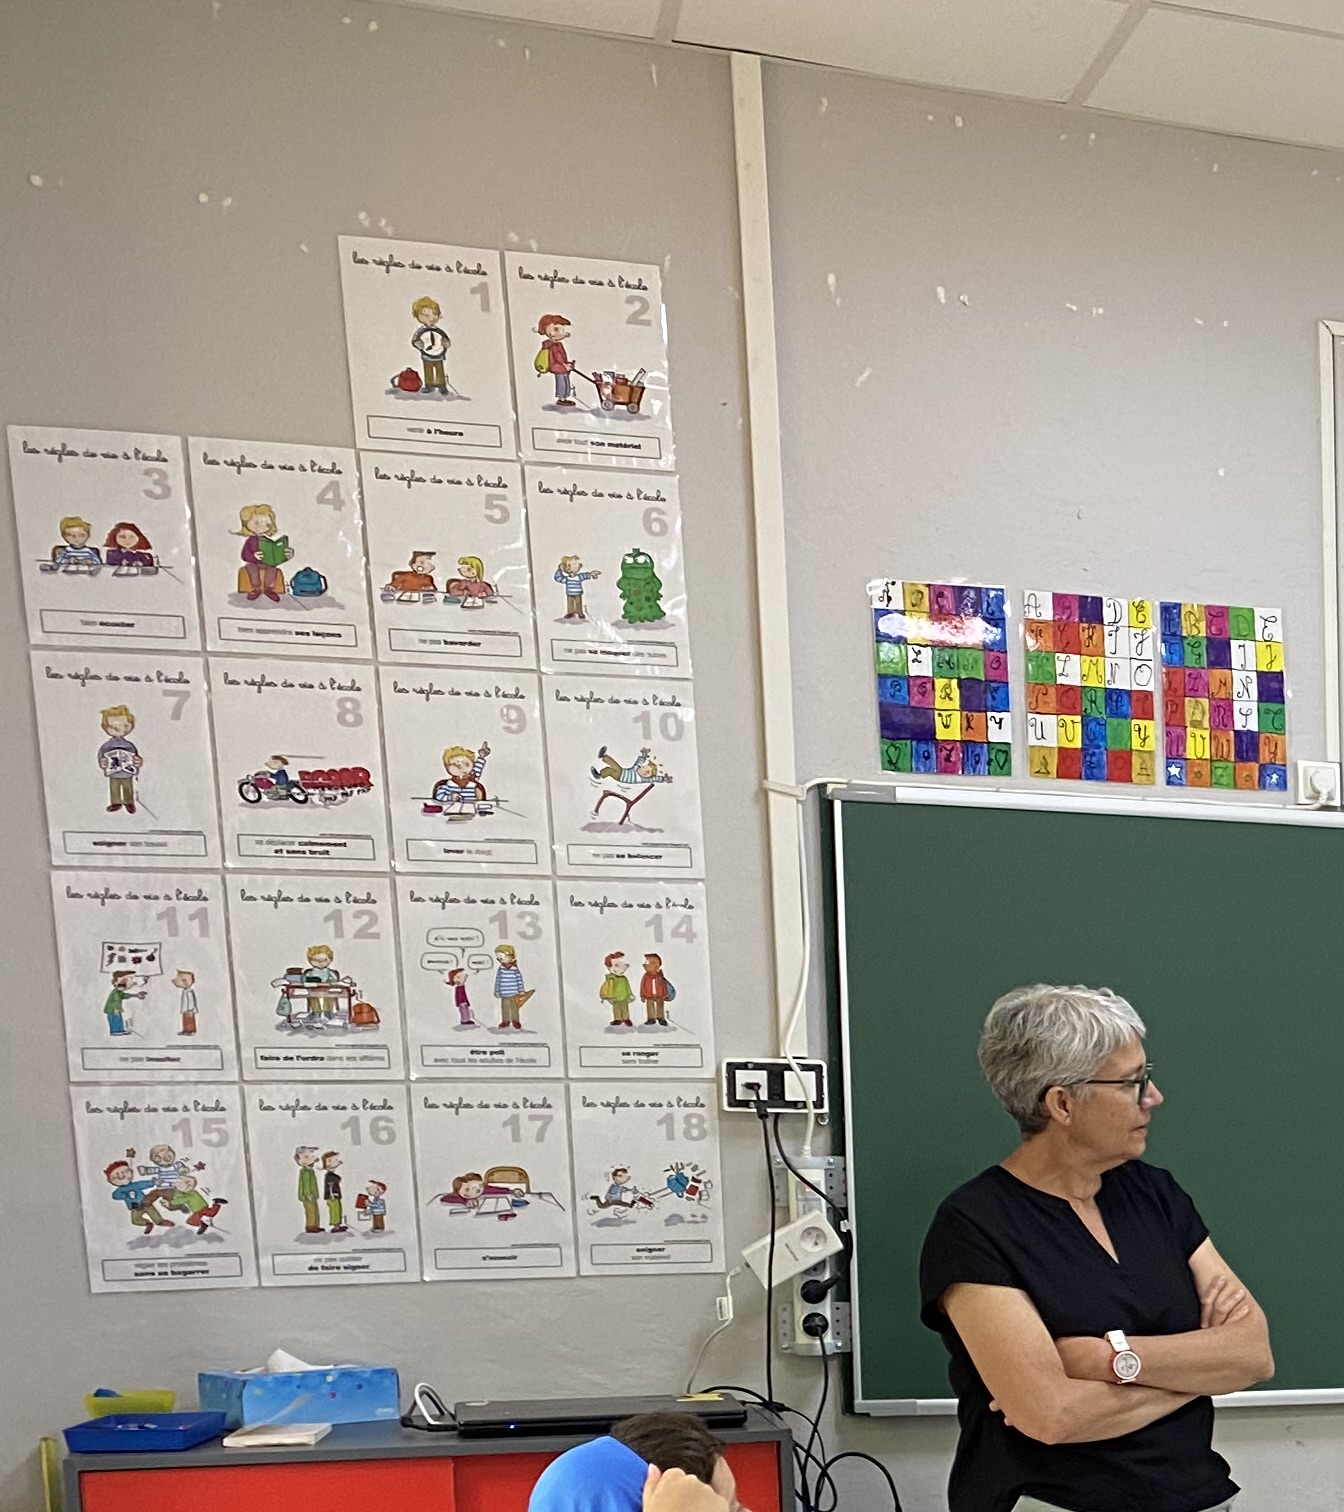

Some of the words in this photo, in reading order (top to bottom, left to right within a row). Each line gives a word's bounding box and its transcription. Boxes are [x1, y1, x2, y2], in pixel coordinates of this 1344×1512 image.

[470, 282, 491, 312] 1
[625, 295, 651, 326] 2
[143, 468, 171, 500] 3
[316, 480, 345, 511] 4
[484, 494, 510, 524] 5
[642, 507, 668, 537] 6
[162, 689, 191, 720] 7
[336, 697, 363, 727] 8
[499, 704, 527, 734] 9
[632, 710, 685, 741] 10
[156, 906, 210, 937] 11
[323, 909, 380, 939] 12
[488, 910, 543, 940] 13
[644, 914, 697, 943] 14
[171, 1117, 229, 1148] 15
[340, 1115, 397, 1146] 16
[502, 1114, 554, 1143] 17
[657, 1113, 708, 1141] 18
